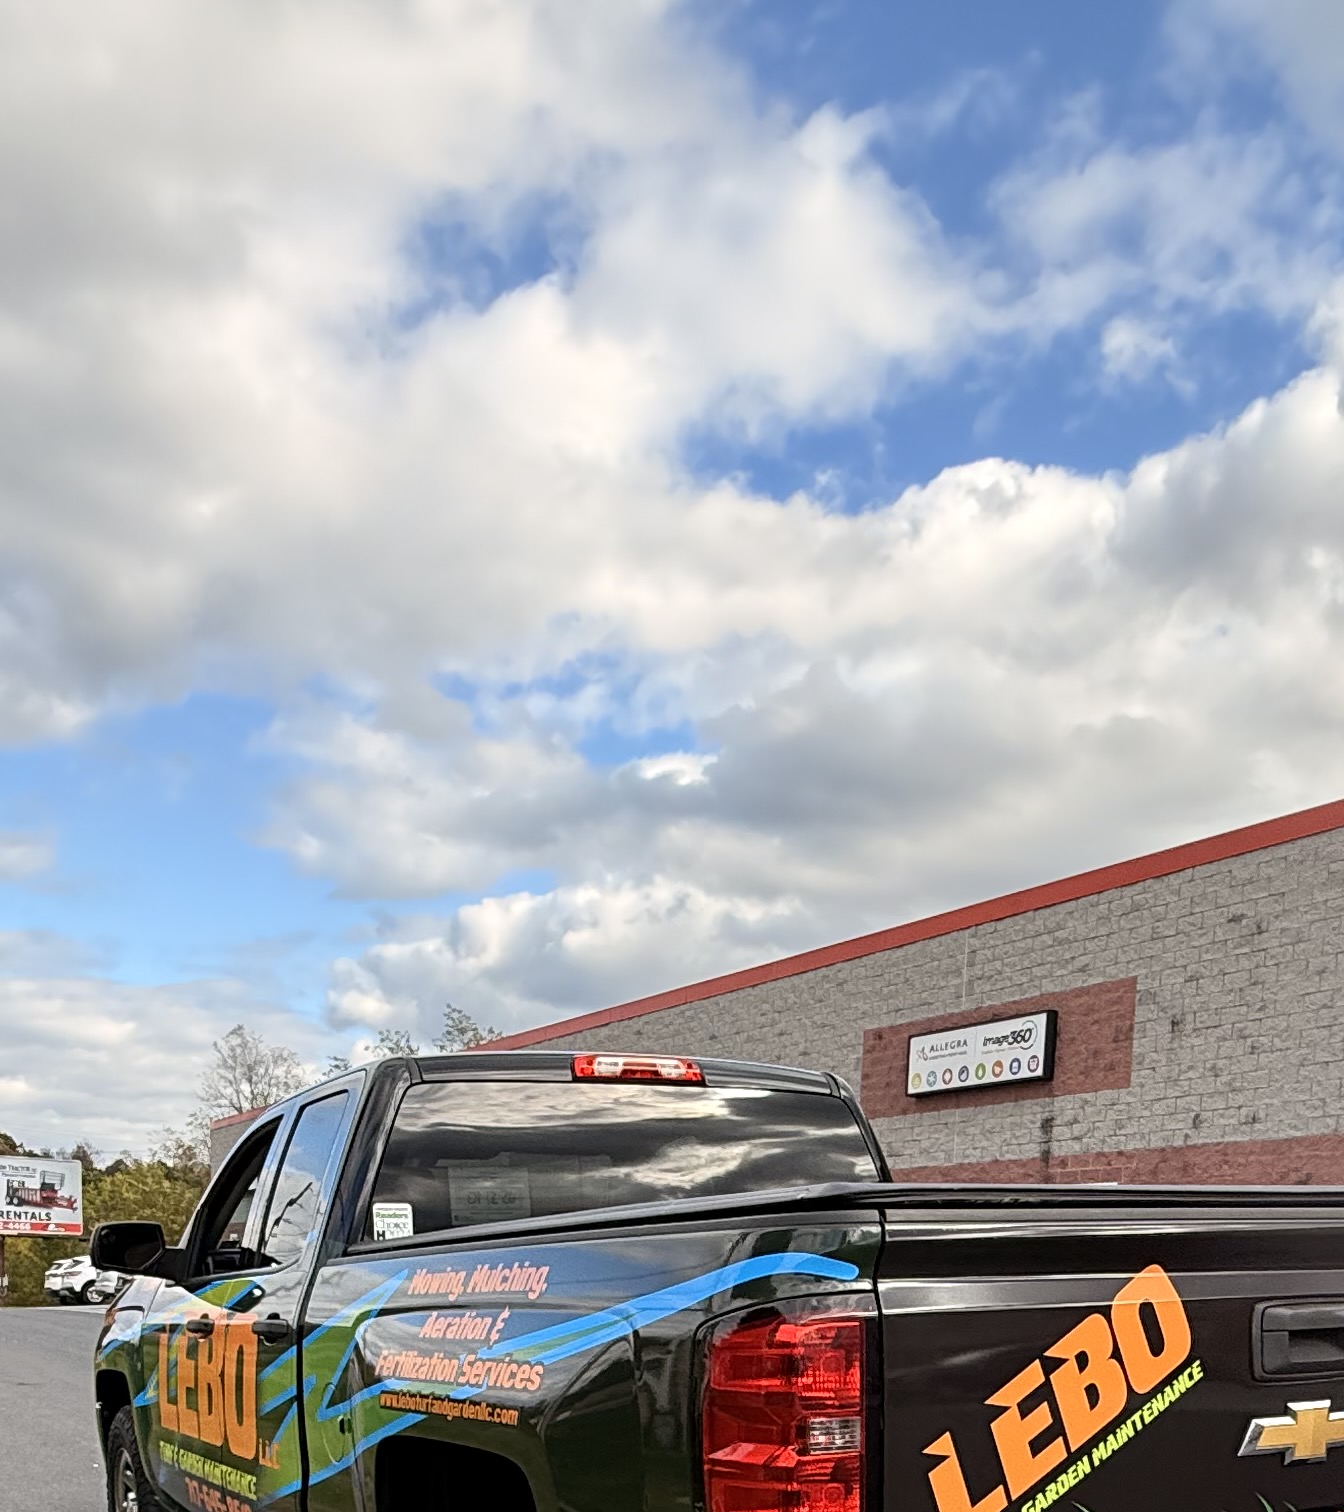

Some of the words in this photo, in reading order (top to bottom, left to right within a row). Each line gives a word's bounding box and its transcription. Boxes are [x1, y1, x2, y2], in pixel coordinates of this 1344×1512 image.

[929, 1038, 968, 1054] ALLEGRA
[419, 1311, 493, 1341] Aeration
[489, 1305, 511, 1346] &
[158, 1310, 258, 1461] LEBO
[374, 1350, 460, 1384] Fertilization
[457, 1353, 545, 1392] Services
[378, 1391, 520, 1427] www.leboturfandgardenllc.com
[1090, 1359, 1205, 1467] MAINTENANCE
